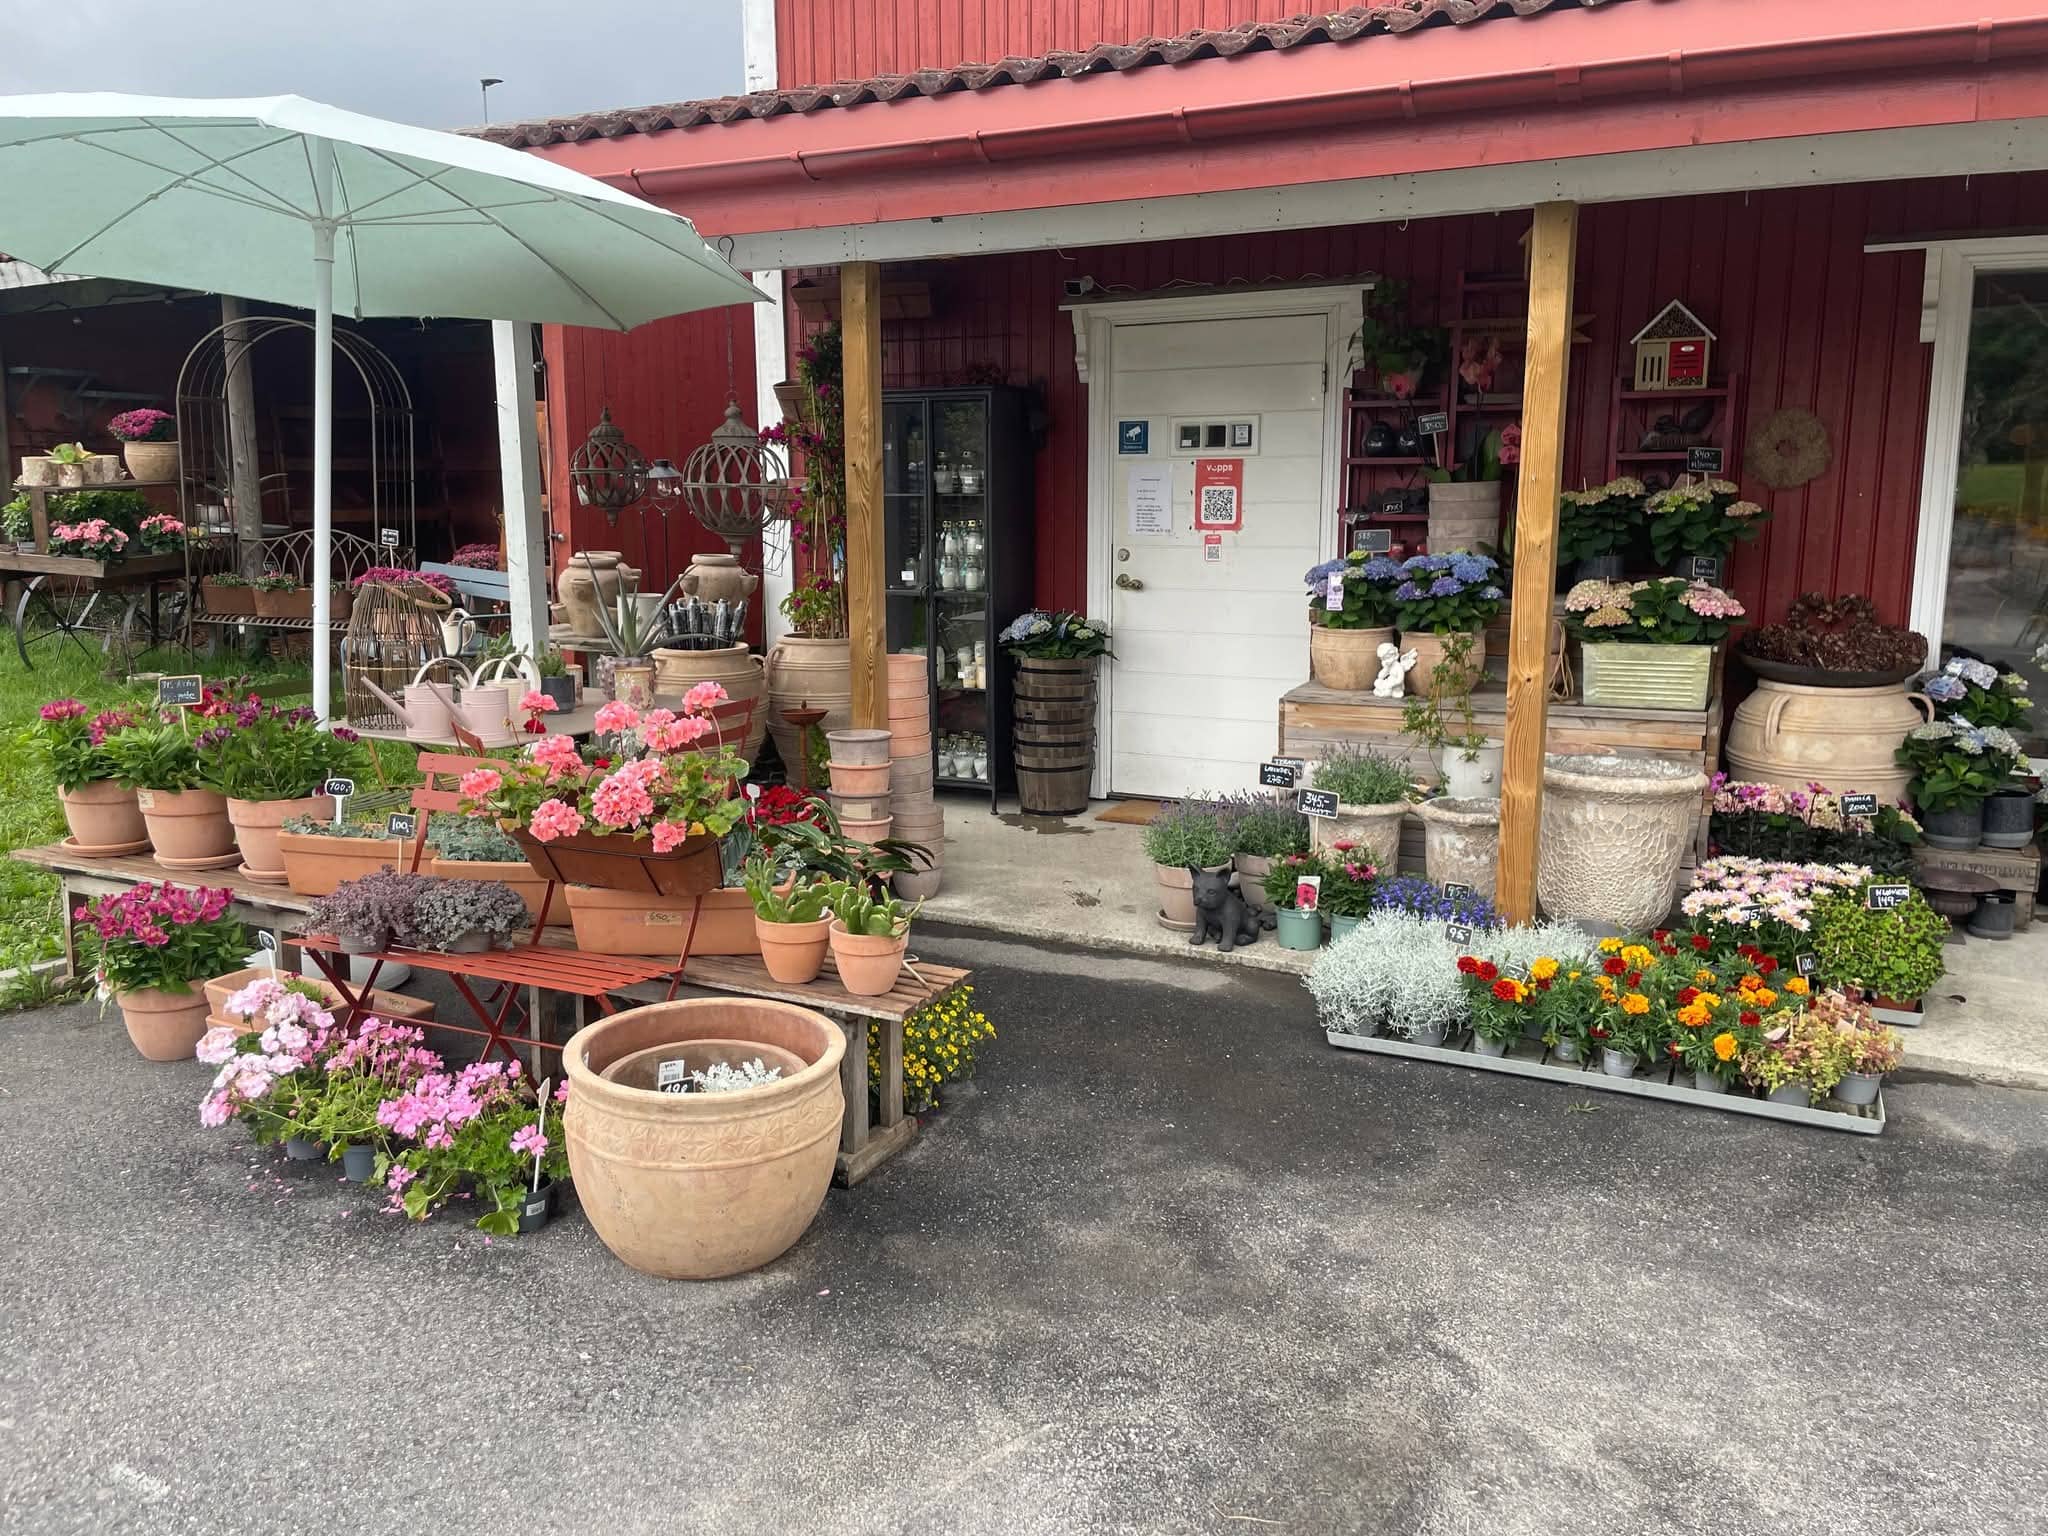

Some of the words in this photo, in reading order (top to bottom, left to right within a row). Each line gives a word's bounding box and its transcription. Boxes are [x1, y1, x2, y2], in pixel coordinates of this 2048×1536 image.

[1304, 792, 1330, 809] 345,-
[1848, 803, 1873, 813] 200,-
[391, 817, 413, 833] 100,-
